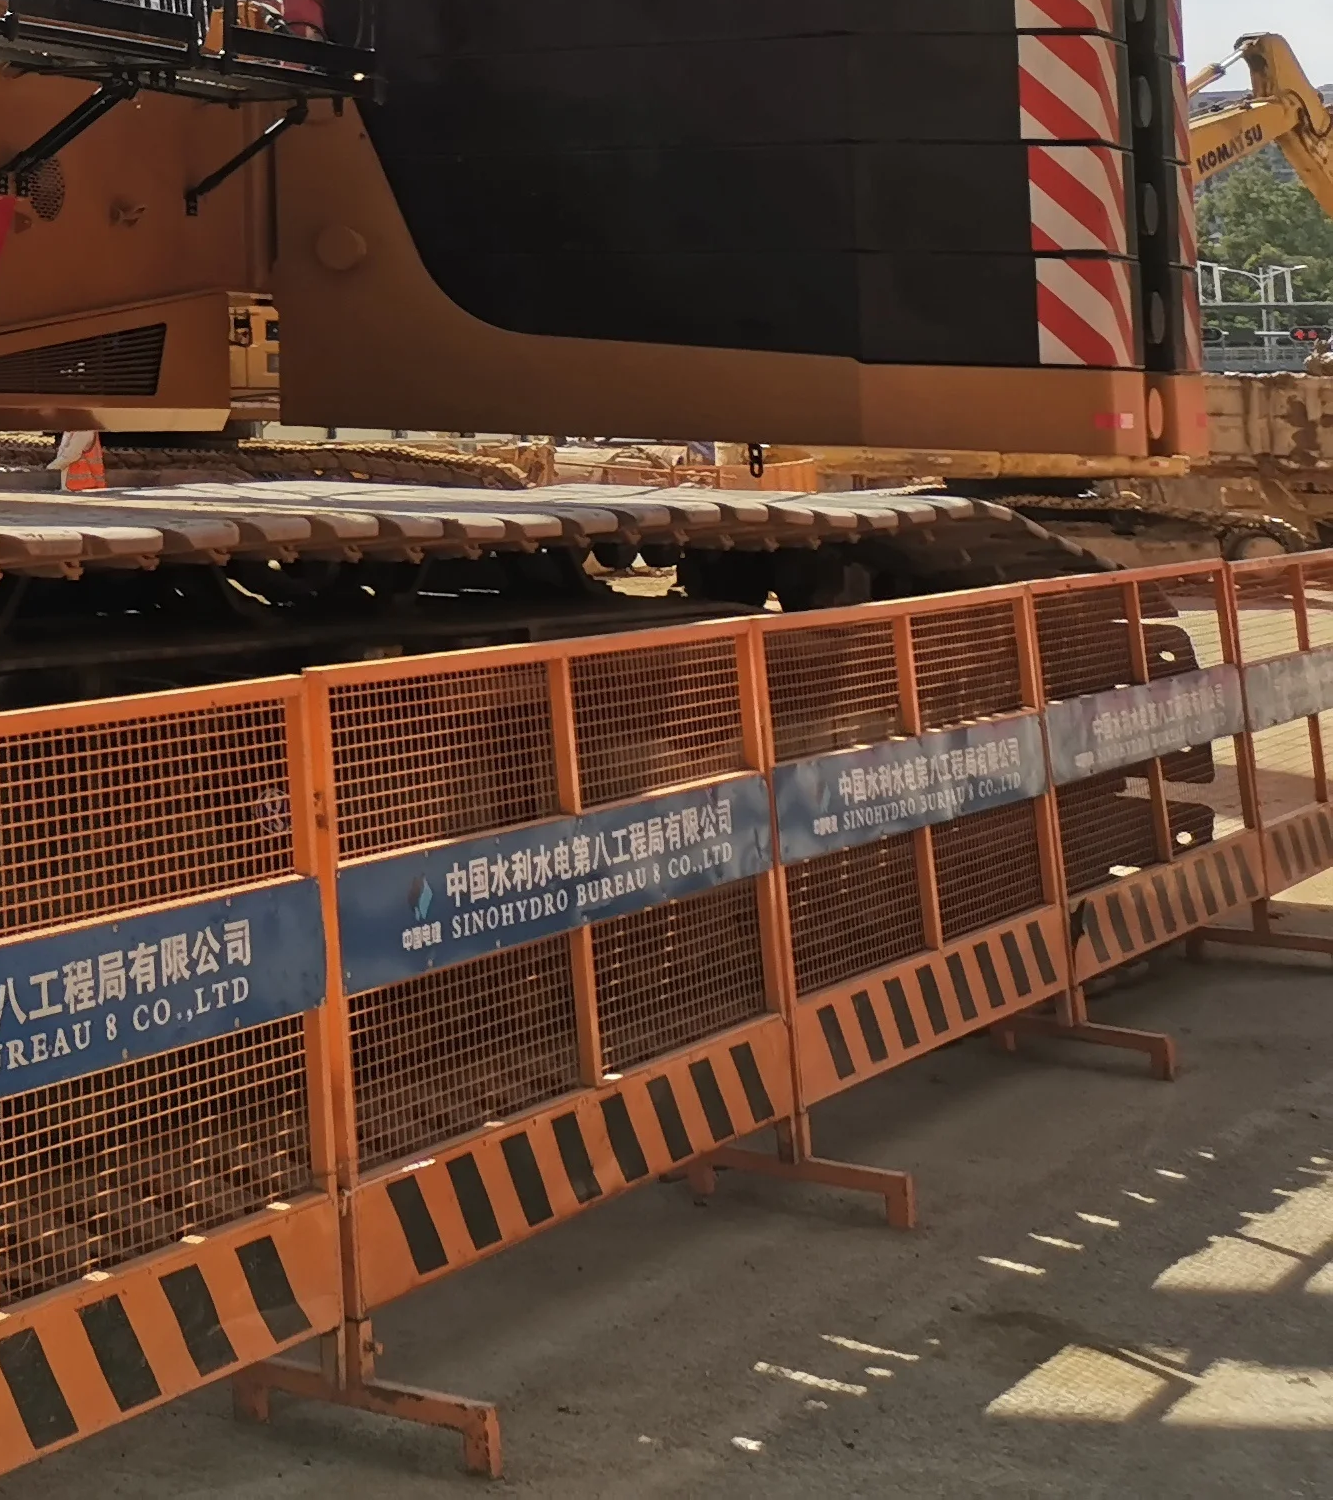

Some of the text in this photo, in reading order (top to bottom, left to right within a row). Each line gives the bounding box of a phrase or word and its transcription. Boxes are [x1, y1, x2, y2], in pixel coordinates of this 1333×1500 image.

[1196, 124, 1263, 174] KOMATSU
[843, 798, 916, 831] SINOHYDRO
[446, 799, 733, 908] 中国水利水电第八工程局有限公司
[452, 890, 569, 939] SINOHYDRO
[576, 865, 647, 907] BUREAU
[668, 842, 733, 879] CO.,LTD
[106, 1012, 118, 1042] 8
[132, 976, 250, 1031] CO.,LTD
